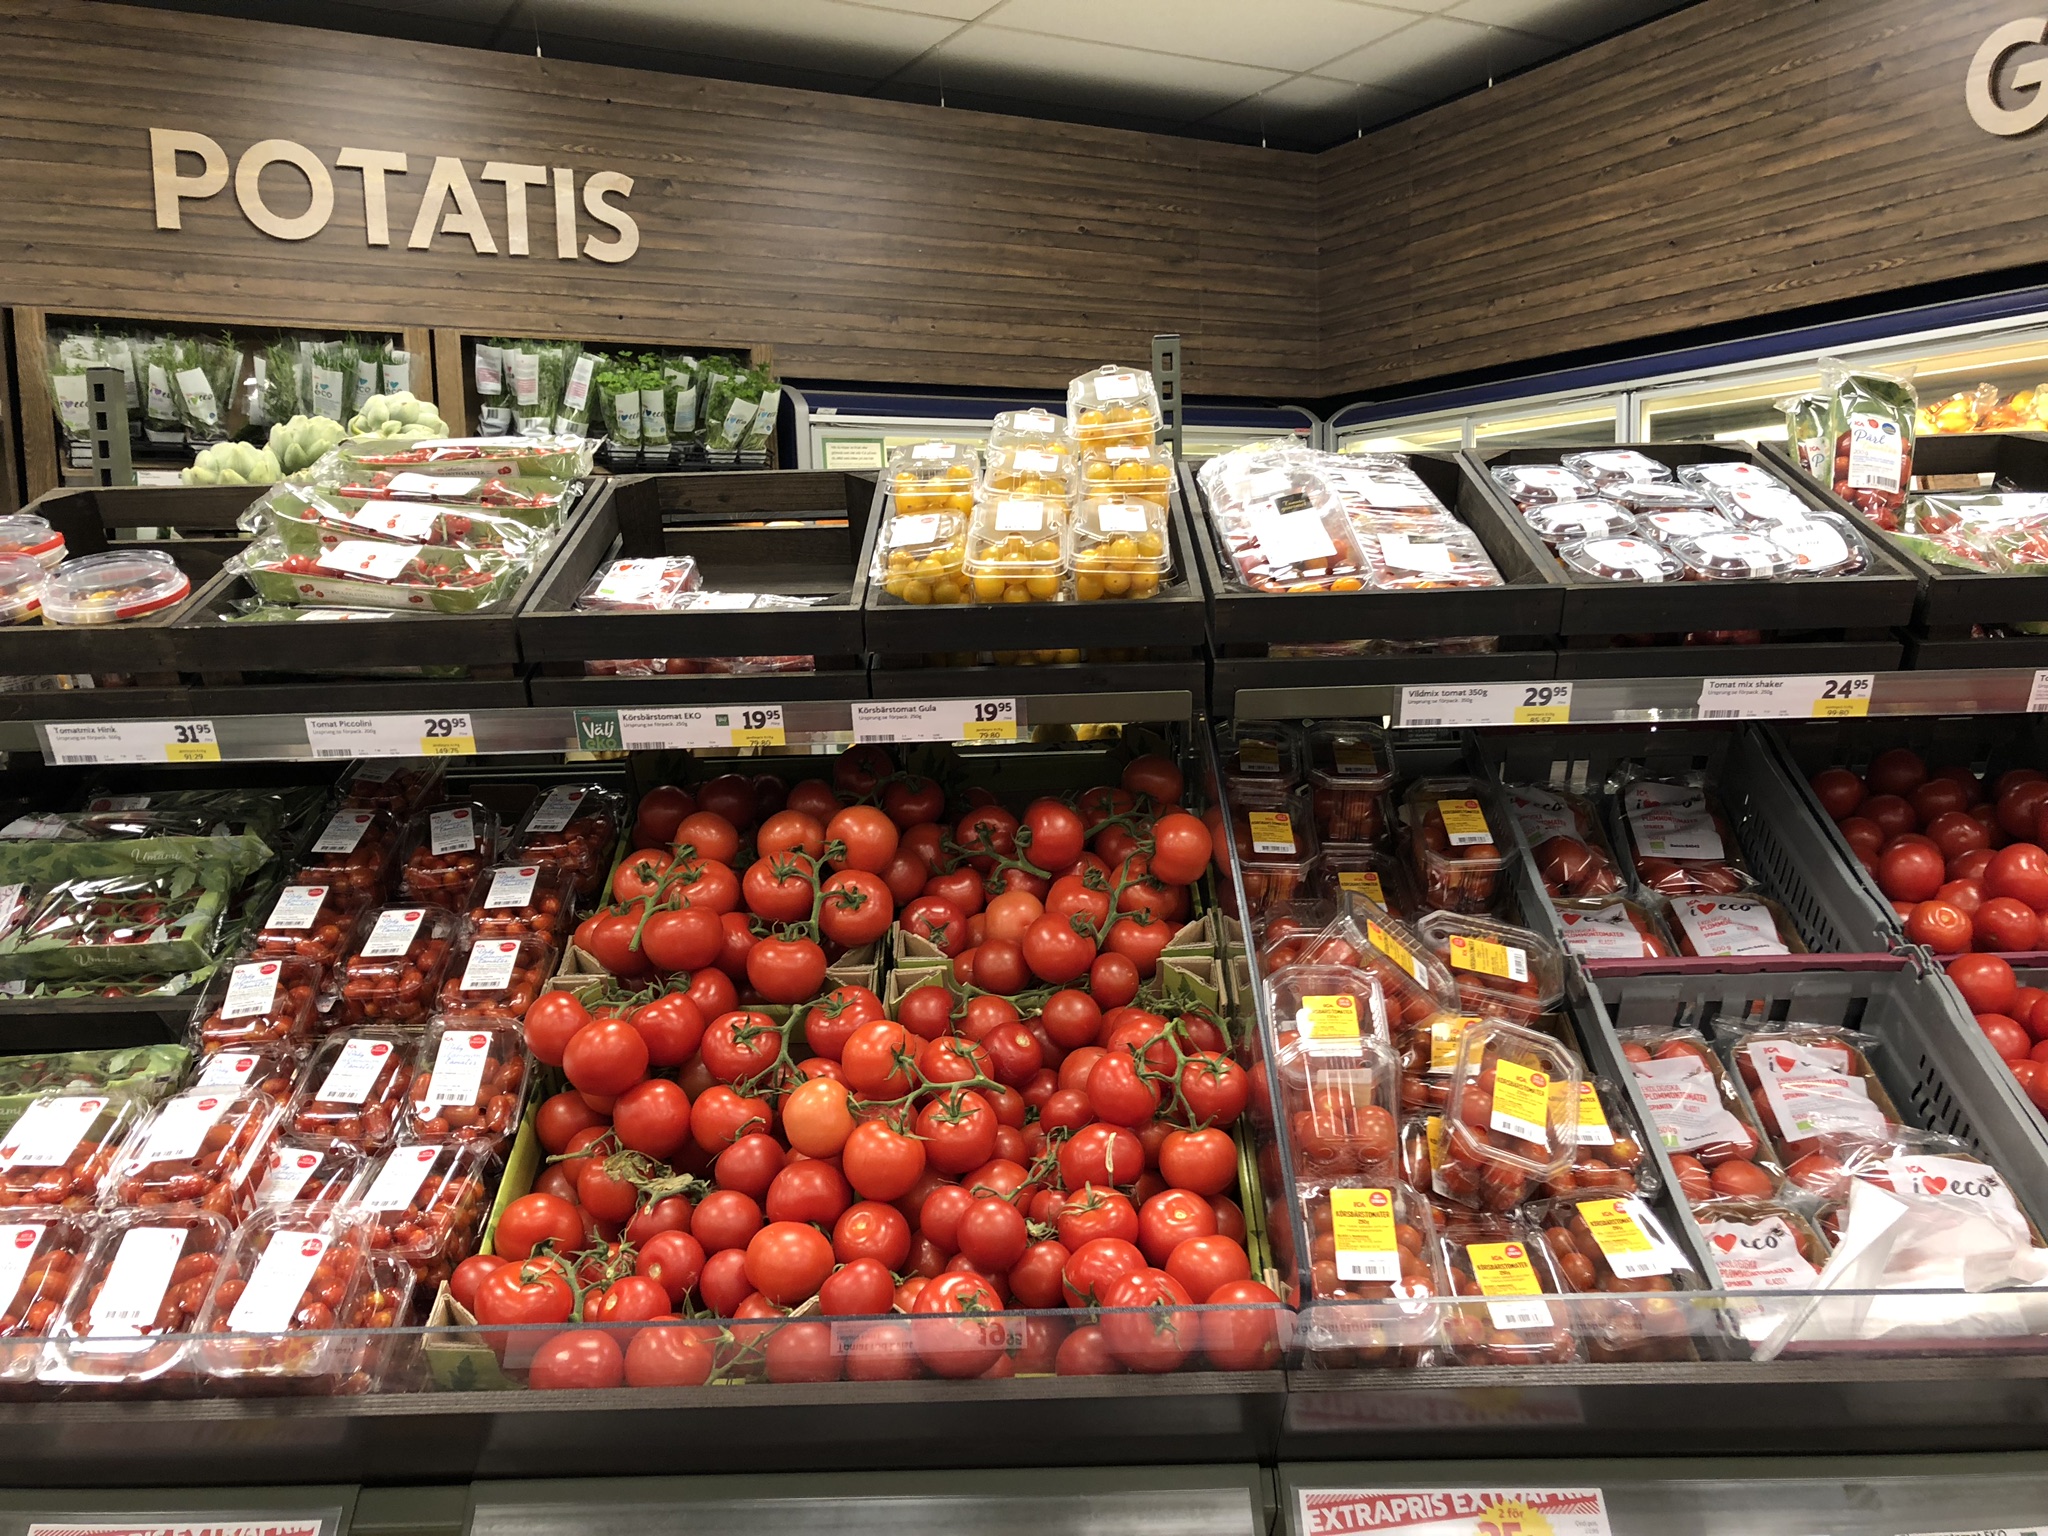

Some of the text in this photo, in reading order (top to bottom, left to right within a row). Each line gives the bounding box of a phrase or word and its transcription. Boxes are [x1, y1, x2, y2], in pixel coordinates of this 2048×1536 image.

[1966, 17, 2048, 135] G
[149, 127, 640, 264] POTATIS
[314, 390, 332, 398] eco
[1409, 690, 1439, 698] Vildmix
[1468, 689, 1488, 697] 350g
[858, 704, 937, 714] Körsbärstomat Gula
[622, 712, 702, 721] Körsbärstomat EKO
[312, 720, 337, 728] Tomat
[54, 727, 96, 735] Tomatmix
[582, 720, 615, 743] Välj
[131, 848, 182, 863] Umami
[1690, 902, 1751, 917] i eco
[1763, 1046, 1780, 1054] ICA
[1644, 1092, 1708, 1103] PLOMMONTOMATER
[1906, 1166, 1926, 1174] ICA
[1913, 1177, 1991, 1198] i eco
[1740, 1235, 1778, 1250] eco
[1310, 1495, 1448, 1533] EXTRAPRIS
[1498, 1508, 1524, 1520] 2 för
